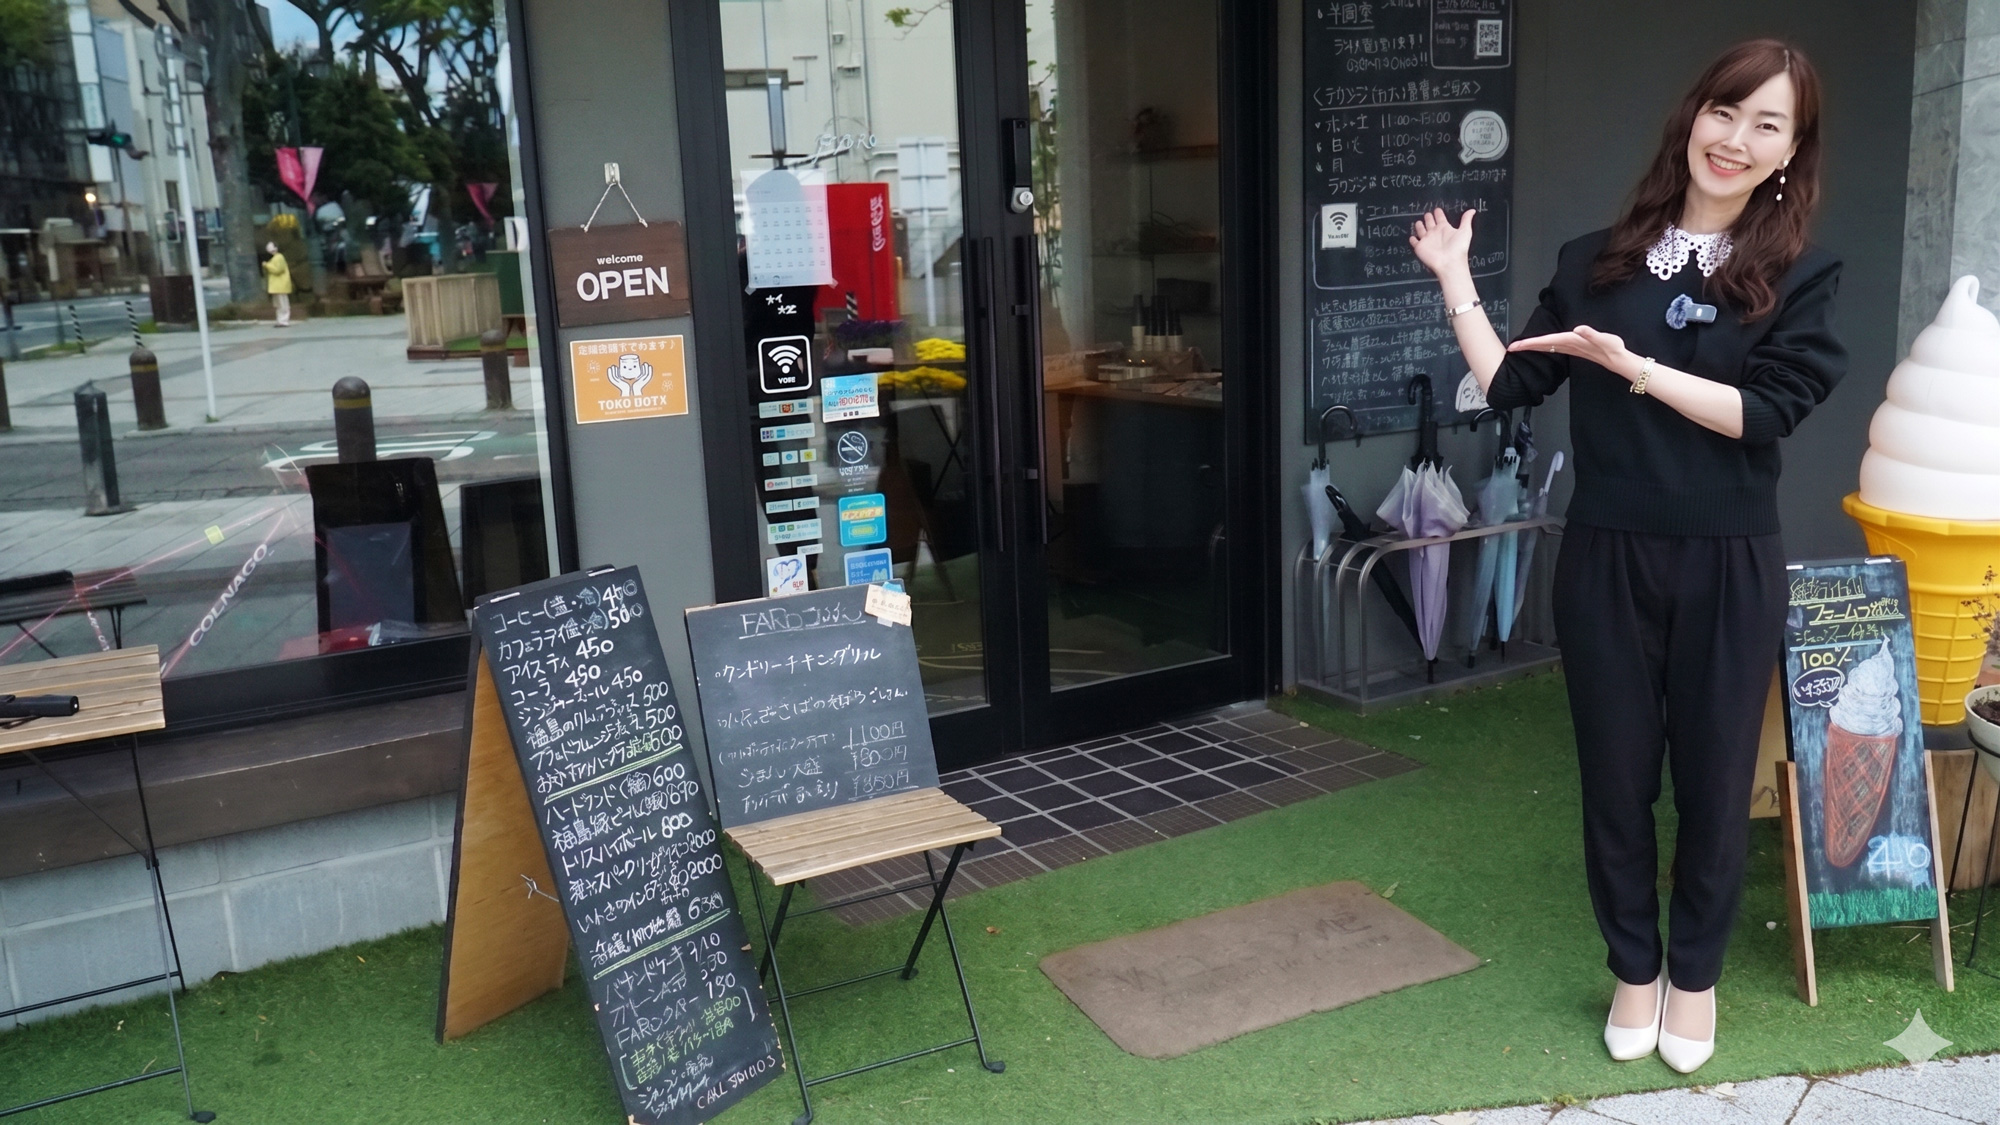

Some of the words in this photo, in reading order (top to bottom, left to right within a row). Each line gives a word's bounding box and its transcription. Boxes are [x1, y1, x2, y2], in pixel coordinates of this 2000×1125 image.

[597, 253, 643, 265] welcome
[576, 266, 670, 302] OPEN
[598, 398, 632, 411] TOKO
[190, 543, 267, 646] COLNAGO
[575, 637, 614, 660] 450
[611, 665, 643, 690] 450
[510, 678, 551, 707] コーラ
[645, 704, 676, 729] 500
[652, 763, 685, 787] 600
